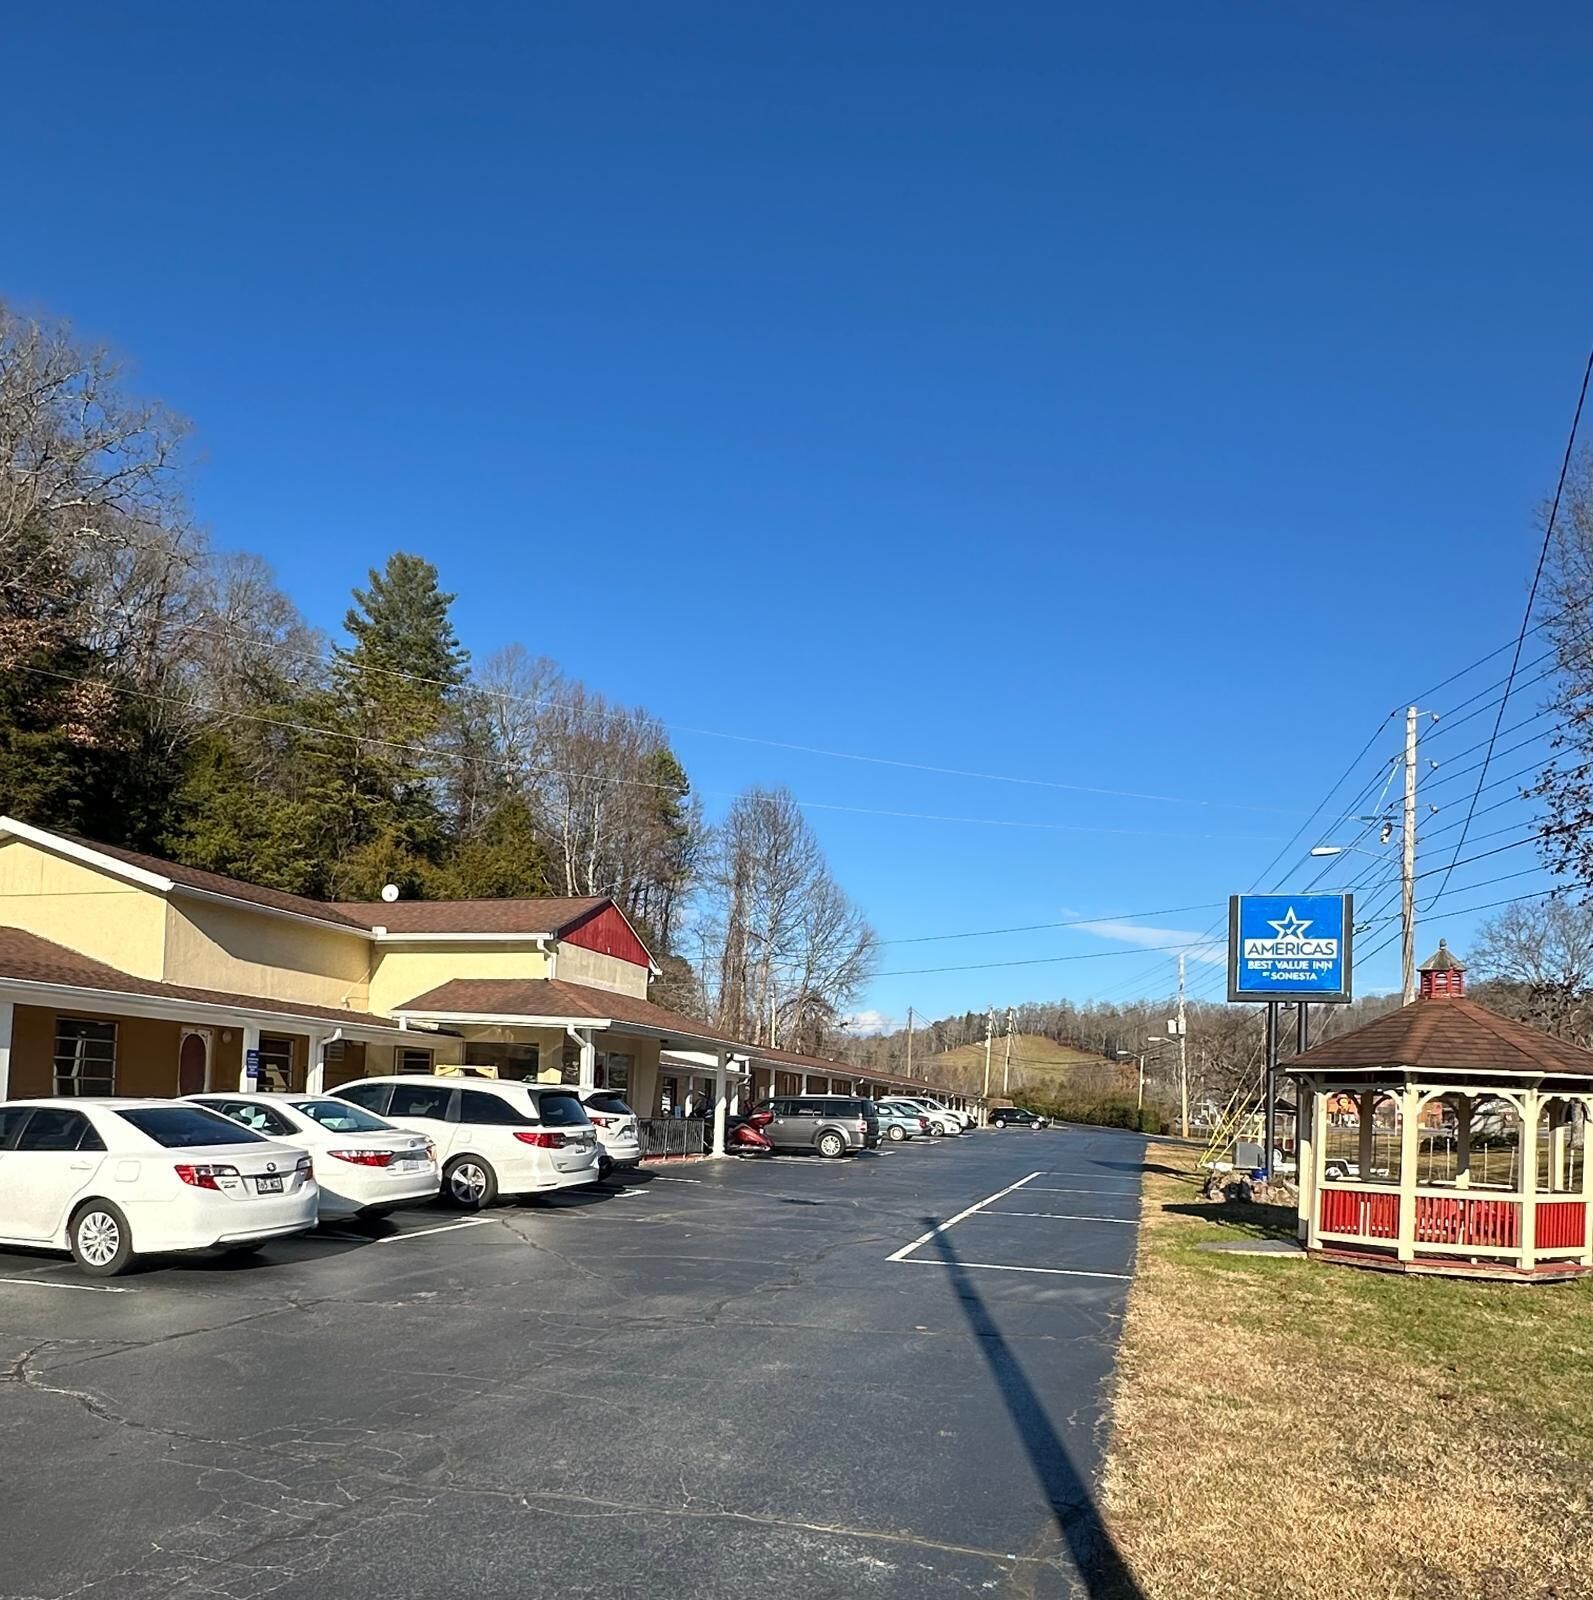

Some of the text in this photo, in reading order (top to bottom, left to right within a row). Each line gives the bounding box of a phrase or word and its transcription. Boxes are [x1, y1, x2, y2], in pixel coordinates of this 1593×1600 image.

[1247, 942, 1334, 956] AMERICAS
[1247, 960, 1333, 970] BEST VALUE INN
[1270, 972, 1318, 980] SONESTA
